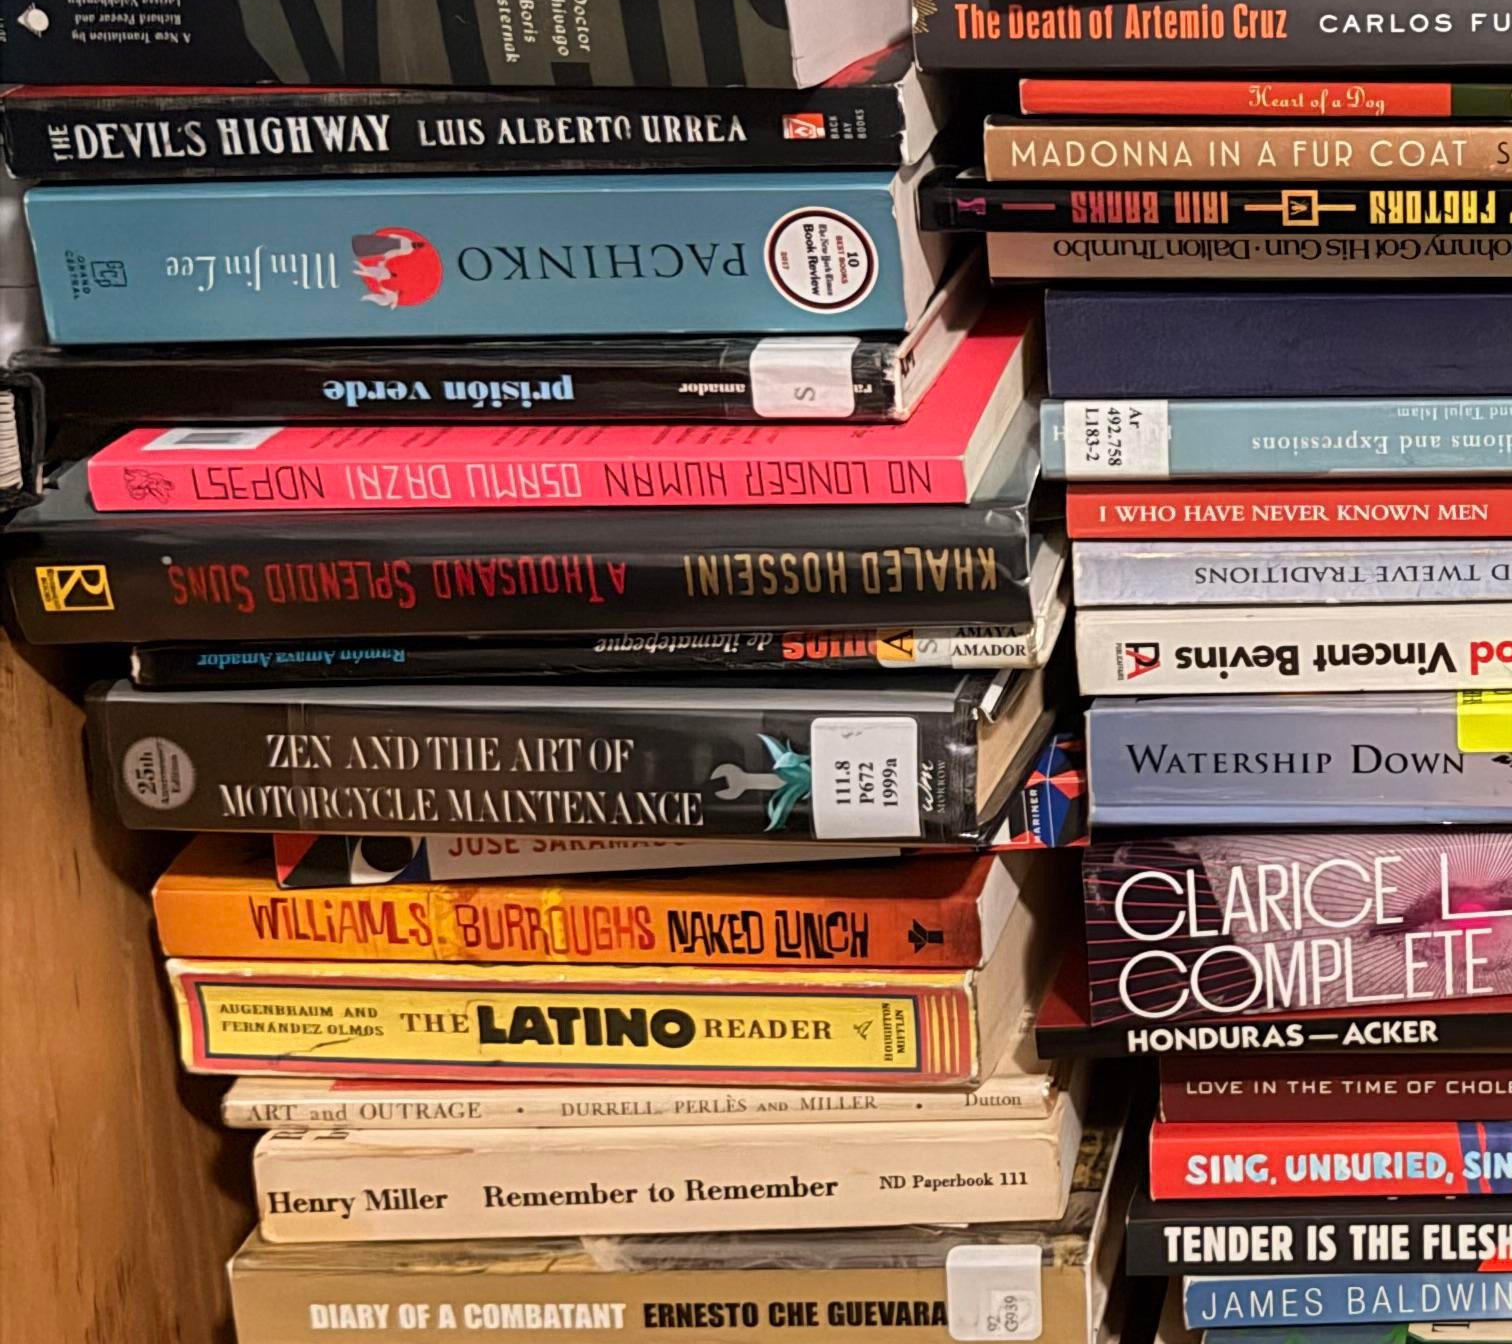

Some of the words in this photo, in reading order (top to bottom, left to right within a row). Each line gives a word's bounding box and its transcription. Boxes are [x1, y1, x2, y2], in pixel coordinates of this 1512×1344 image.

[955, 4, 1000, 39] The
[1008, 4, 1081, 39] Death
[1087, 4, 1113, 40] of
[1126, 4, 1224, 38] Artemio
[1234, 4, 1287, 38] Cruz
[1320, 14, 1452, 33] CARLOS
[803, 224, 816, 253] Book
[458, 243, 747, 281] PACHINKO
[808, 256, 820, 295] Review
[324, 381, 430, 407] verde
[444, 375, 573, 408] prisión
[1099, 505, 1106, 522] I
[1115, 506, 1176, 521] WHO
[1185, 506, 1244, 521] HAVE
[1253, 505, 1329, 521] NEVER
[1337, 505, 1429, 520] KNOWN
[1439, 505, 1488, 520] MEN
[267, 735, 331, 768] ZEN
[346, 737, 418, 769] AND
[426, 737, 500, 771] THE
[511, 739, 581, 772] ART
[590, 739, 633, 772] OF
[859, 763, 874, 803] P672
[883, 759, 898, 806] 1999a
[220, 785, 438, 820] MOTORCYCLE
[448, 789, 703, 825] MAINTENANCE
[400, 1013, 469, 1033] THE
[478, 1006, 694, 1048] LATINO
[705, 1019, 831, 1039] READER
[1187, 1082, 1242, 1094] LOVE
[1255, 1082, 1276, 1093] IN
[1287, 1081, 1331, 1093] THE
[1342, 1081, 1397, 1093] TIME
[1406, 1080, 1436, 1094] OF
[484, 1183, 638, 1207] Remember
[648, 1184, 674, 1202] to
[686, 1176, 838, 1201] Remember
[880, 1176, 906, 1189] ND
[913, 1173, 993, 1192] Paperbook
[1000, 1172, 1027, 1185] 111
